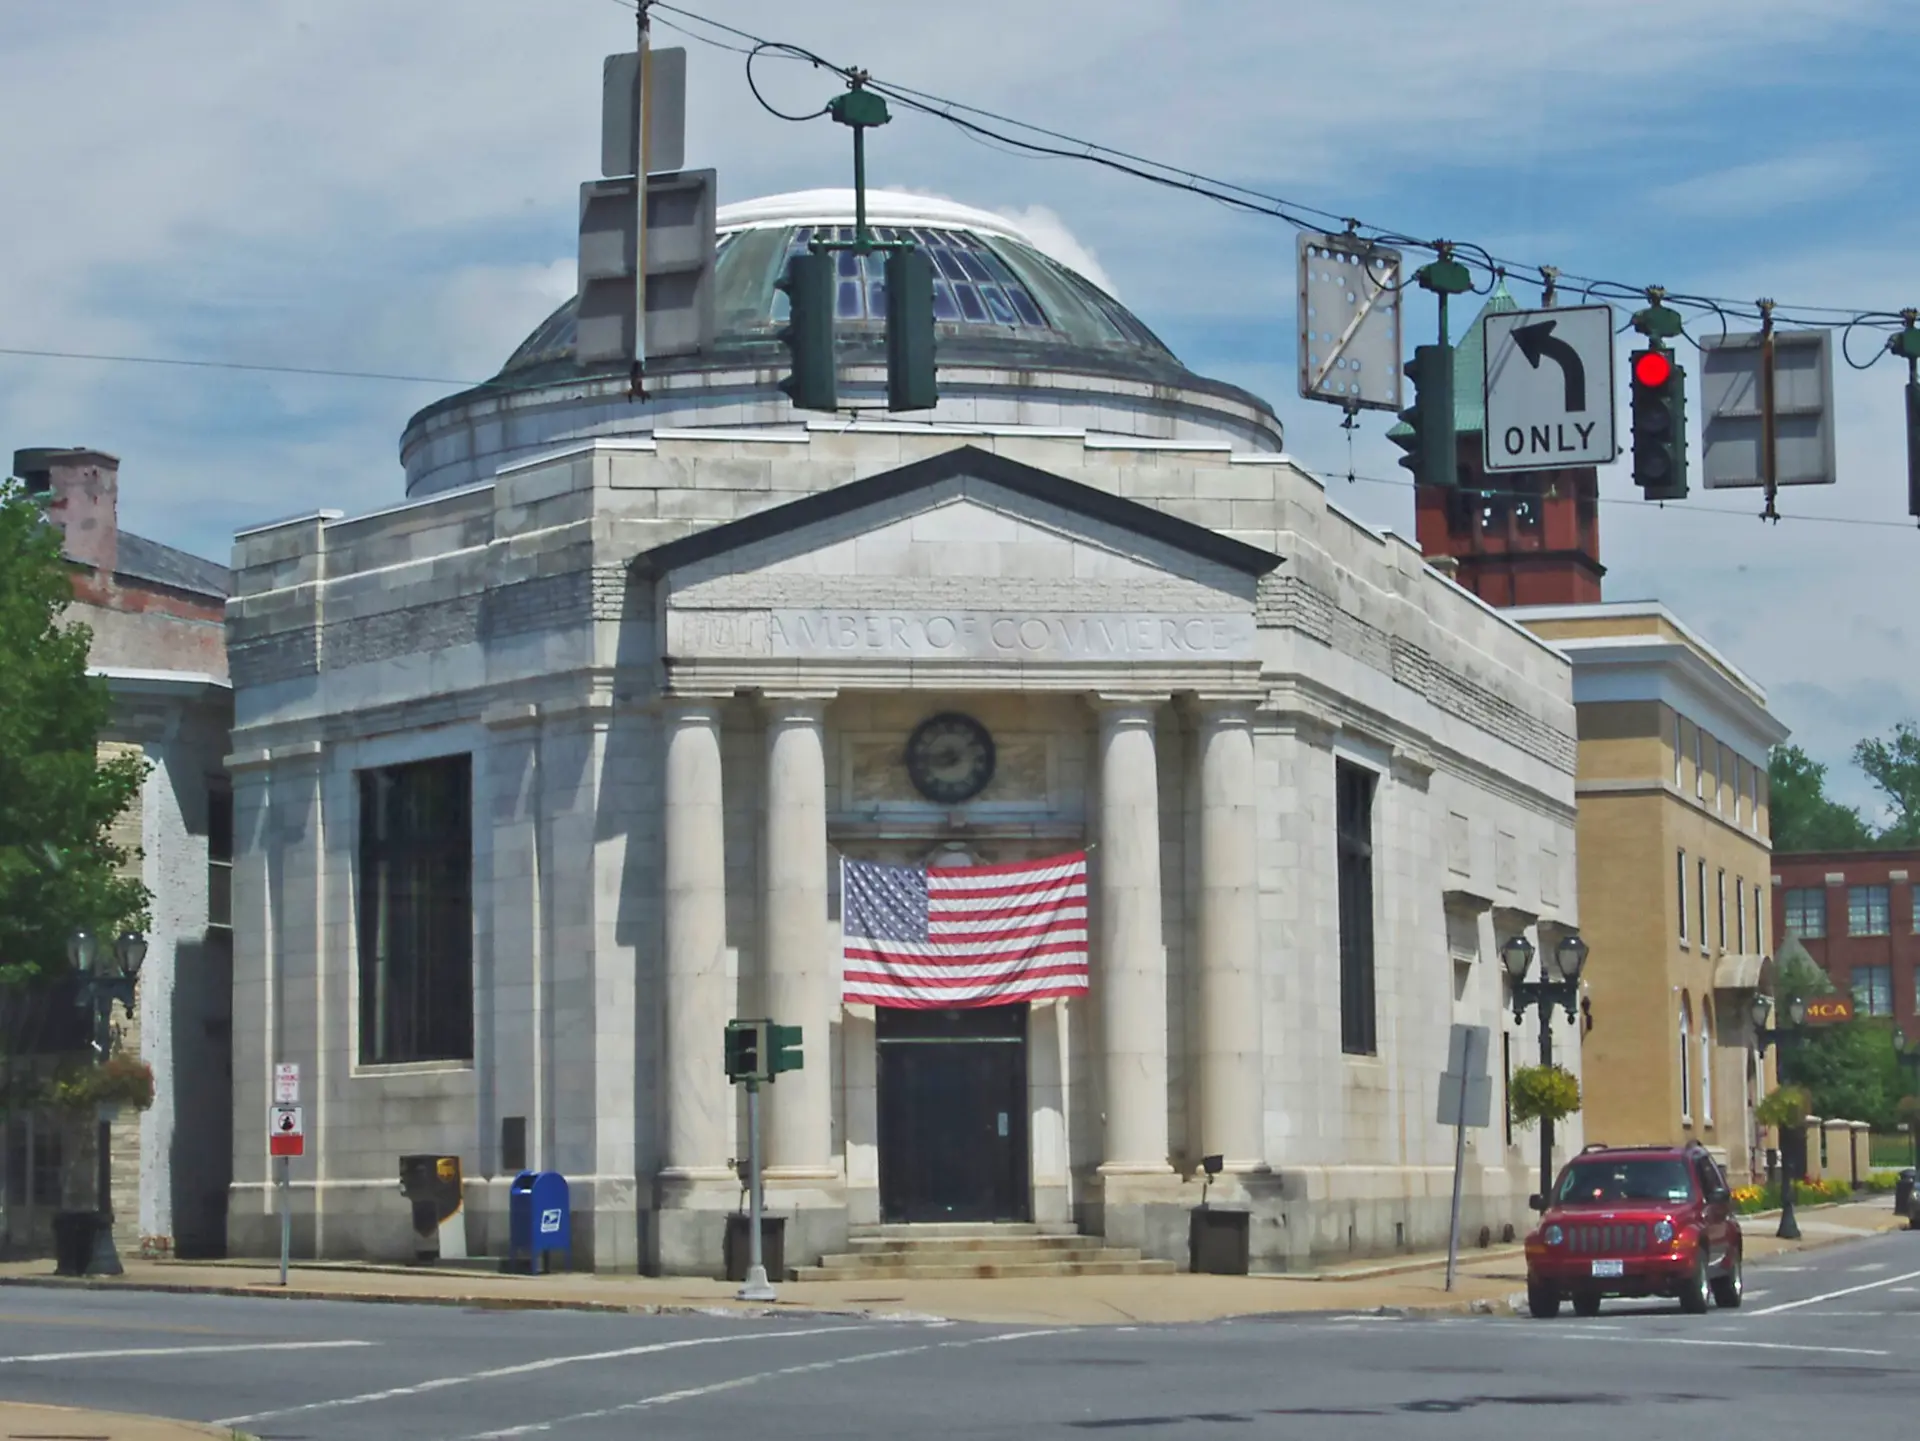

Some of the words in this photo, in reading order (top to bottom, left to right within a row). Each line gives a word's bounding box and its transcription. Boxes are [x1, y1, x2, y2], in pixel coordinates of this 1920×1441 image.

[1504, 421, 1596, 455] ONLY
[924, 614, 976, 651] OF
[990, 616, 1231, 653] COMMERCE
